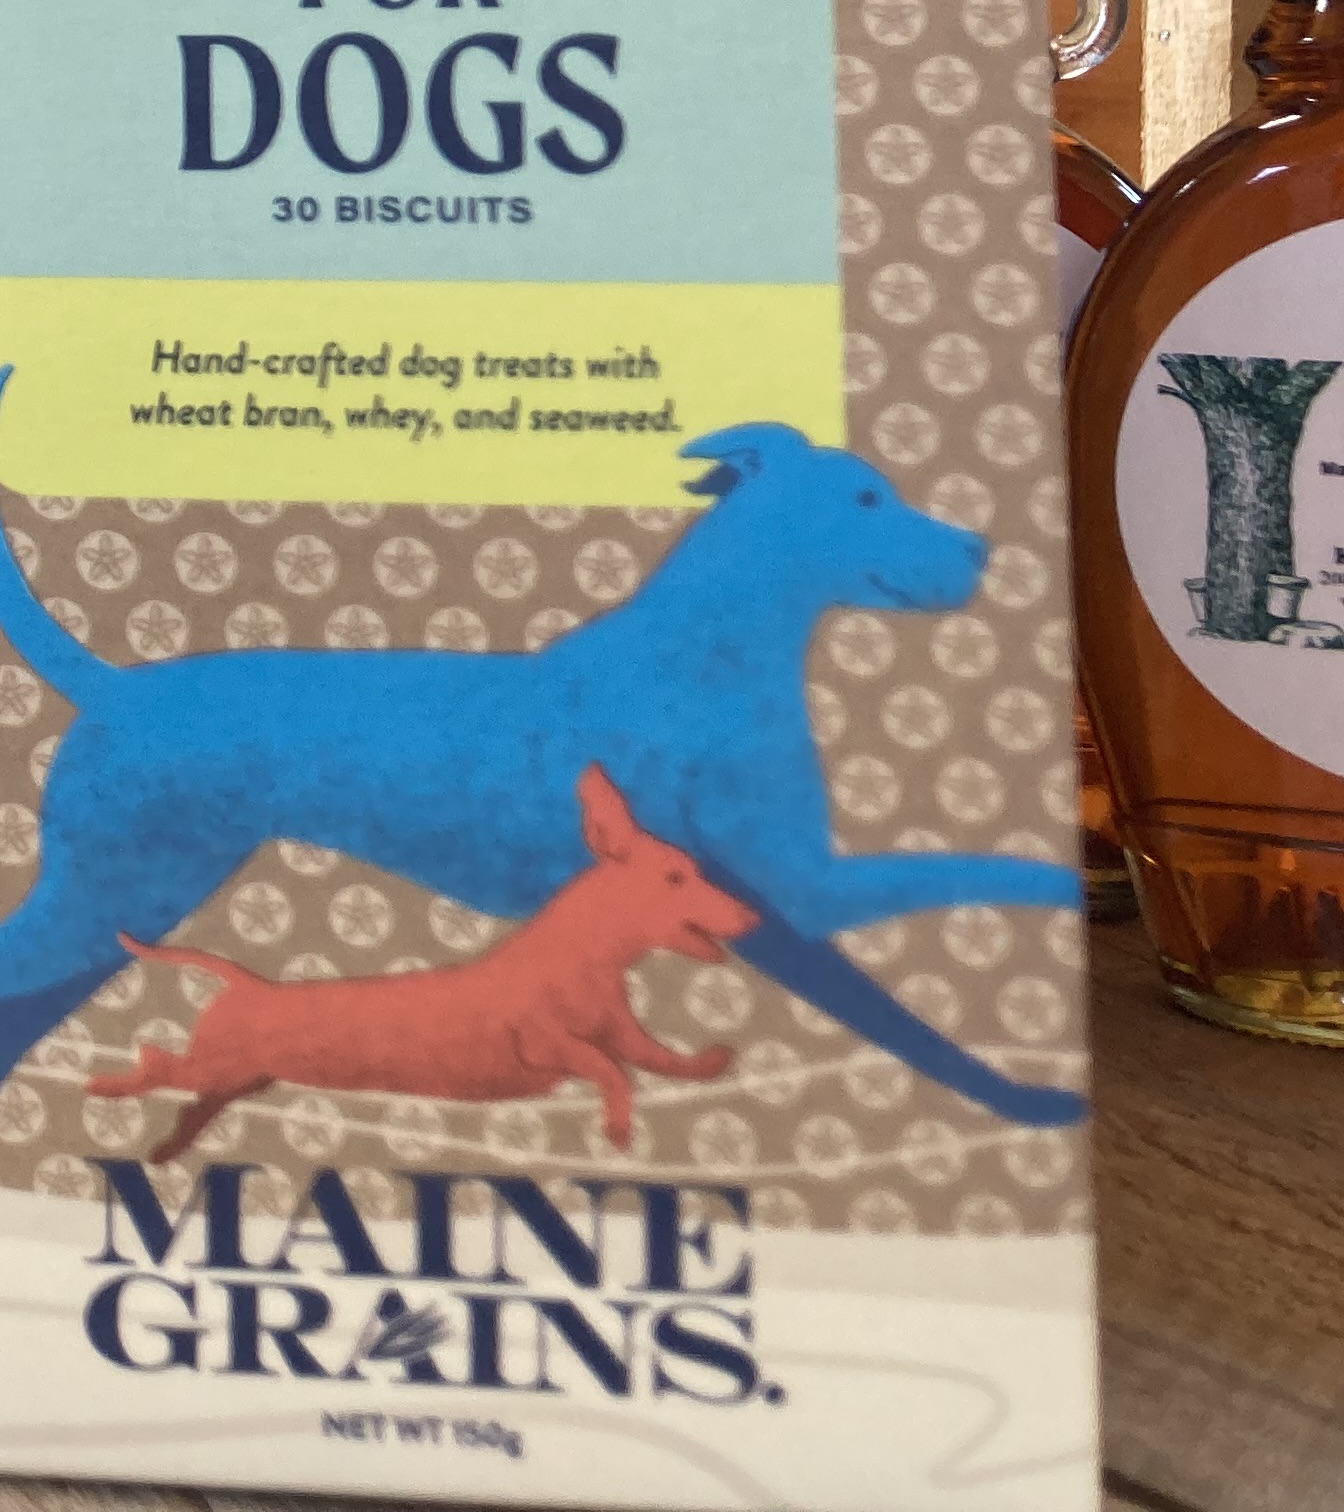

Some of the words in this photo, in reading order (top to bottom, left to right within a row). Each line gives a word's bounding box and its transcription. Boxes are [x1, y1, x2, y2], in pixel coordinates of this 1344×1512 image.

[176, 31, 629, 177] DOGS
[271, 194, 322, 224] 30
[333, 195, 534, 225] BISCUITS
[150, 339, 393, 389] Hand-crafted
[398, 342, 464, 391] dog
[474, 349, 574, 380] treats
[585, 345, 662, 380] with
[129, 391, 233, 427] wheat
[242, 392, 337, 437] bran,
[342, 393, 444, 442] whey,
[452, 395, 522, 432] and
[527, 397, 683, 433] seaweed.
[82, 1155, 759, 1298] MAINE
[81, 1269, 789, 1408] GRAINS.
[319, 1409, 386, 1443] NET
[393, 1414, 445, 1446] WT
